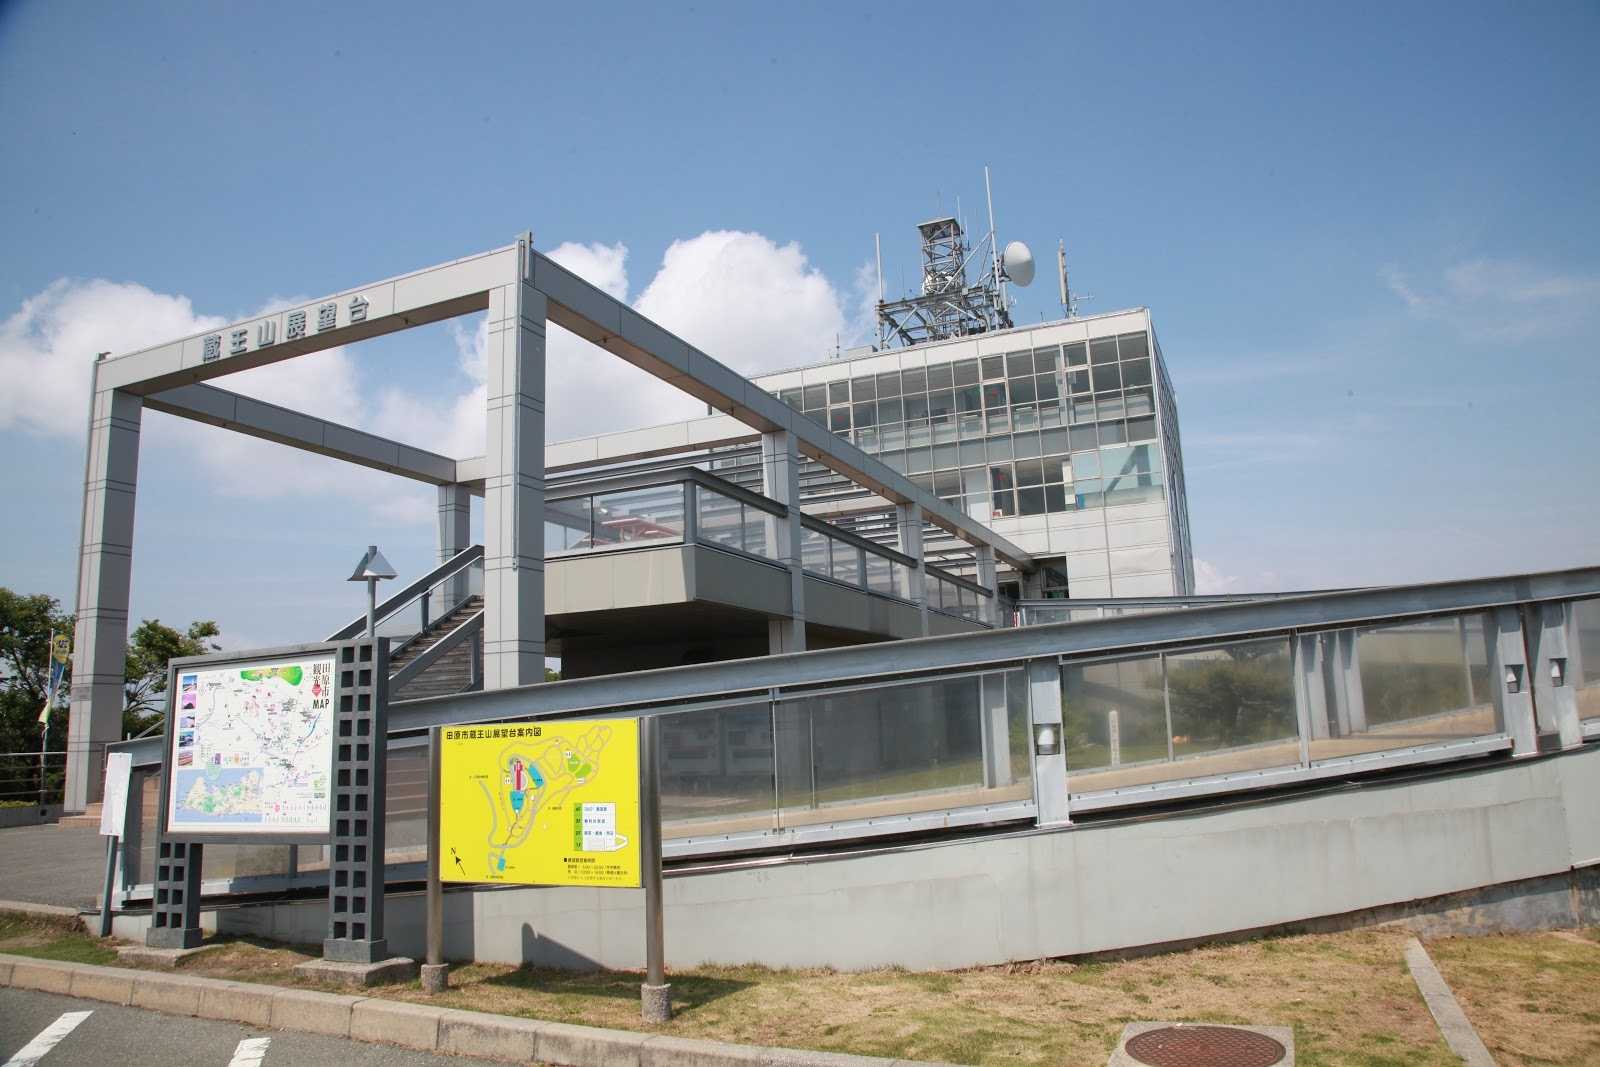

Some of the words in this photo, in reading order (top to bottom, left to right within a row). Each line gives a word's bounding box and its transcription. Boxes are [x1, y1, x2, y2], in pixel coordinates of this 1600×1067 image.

[203, 295, 369, 362] 蔵王山展望台
[322, 662, 331, 697] 田原市
[313, 698, 330, 710] MAP
[446, 726, 542, 740] 田原市蔵王山展望台案内図
[450, 847, 457, 855] N
